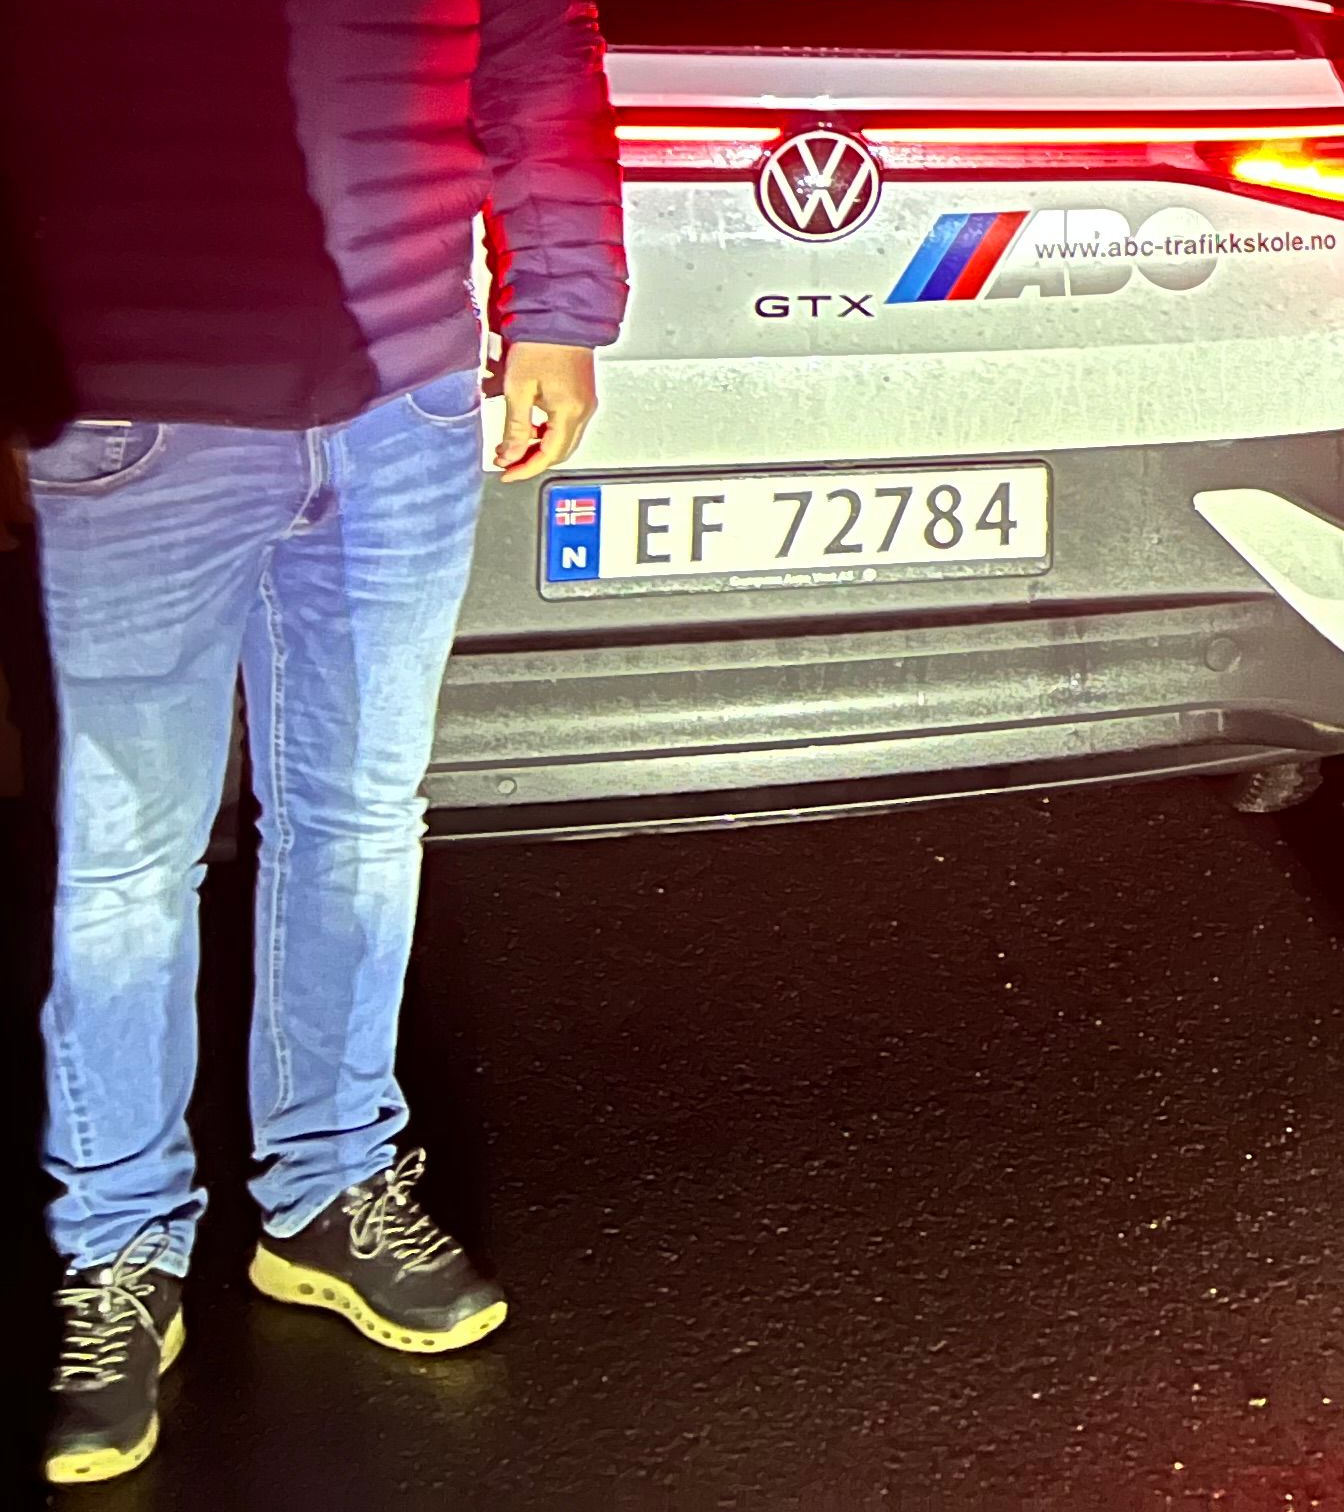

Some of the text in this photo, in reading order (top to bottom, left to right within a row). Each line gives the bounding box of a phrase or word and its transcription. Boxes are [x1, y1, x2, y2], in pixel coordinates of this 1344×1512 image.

[1035, 231, 1337, 259] www.abc-trafikkskole.no
[754, 294, 875, 318] GTX
[636, 481, 1018, 565] EF 72784
[562, 545, 587, 570] N
